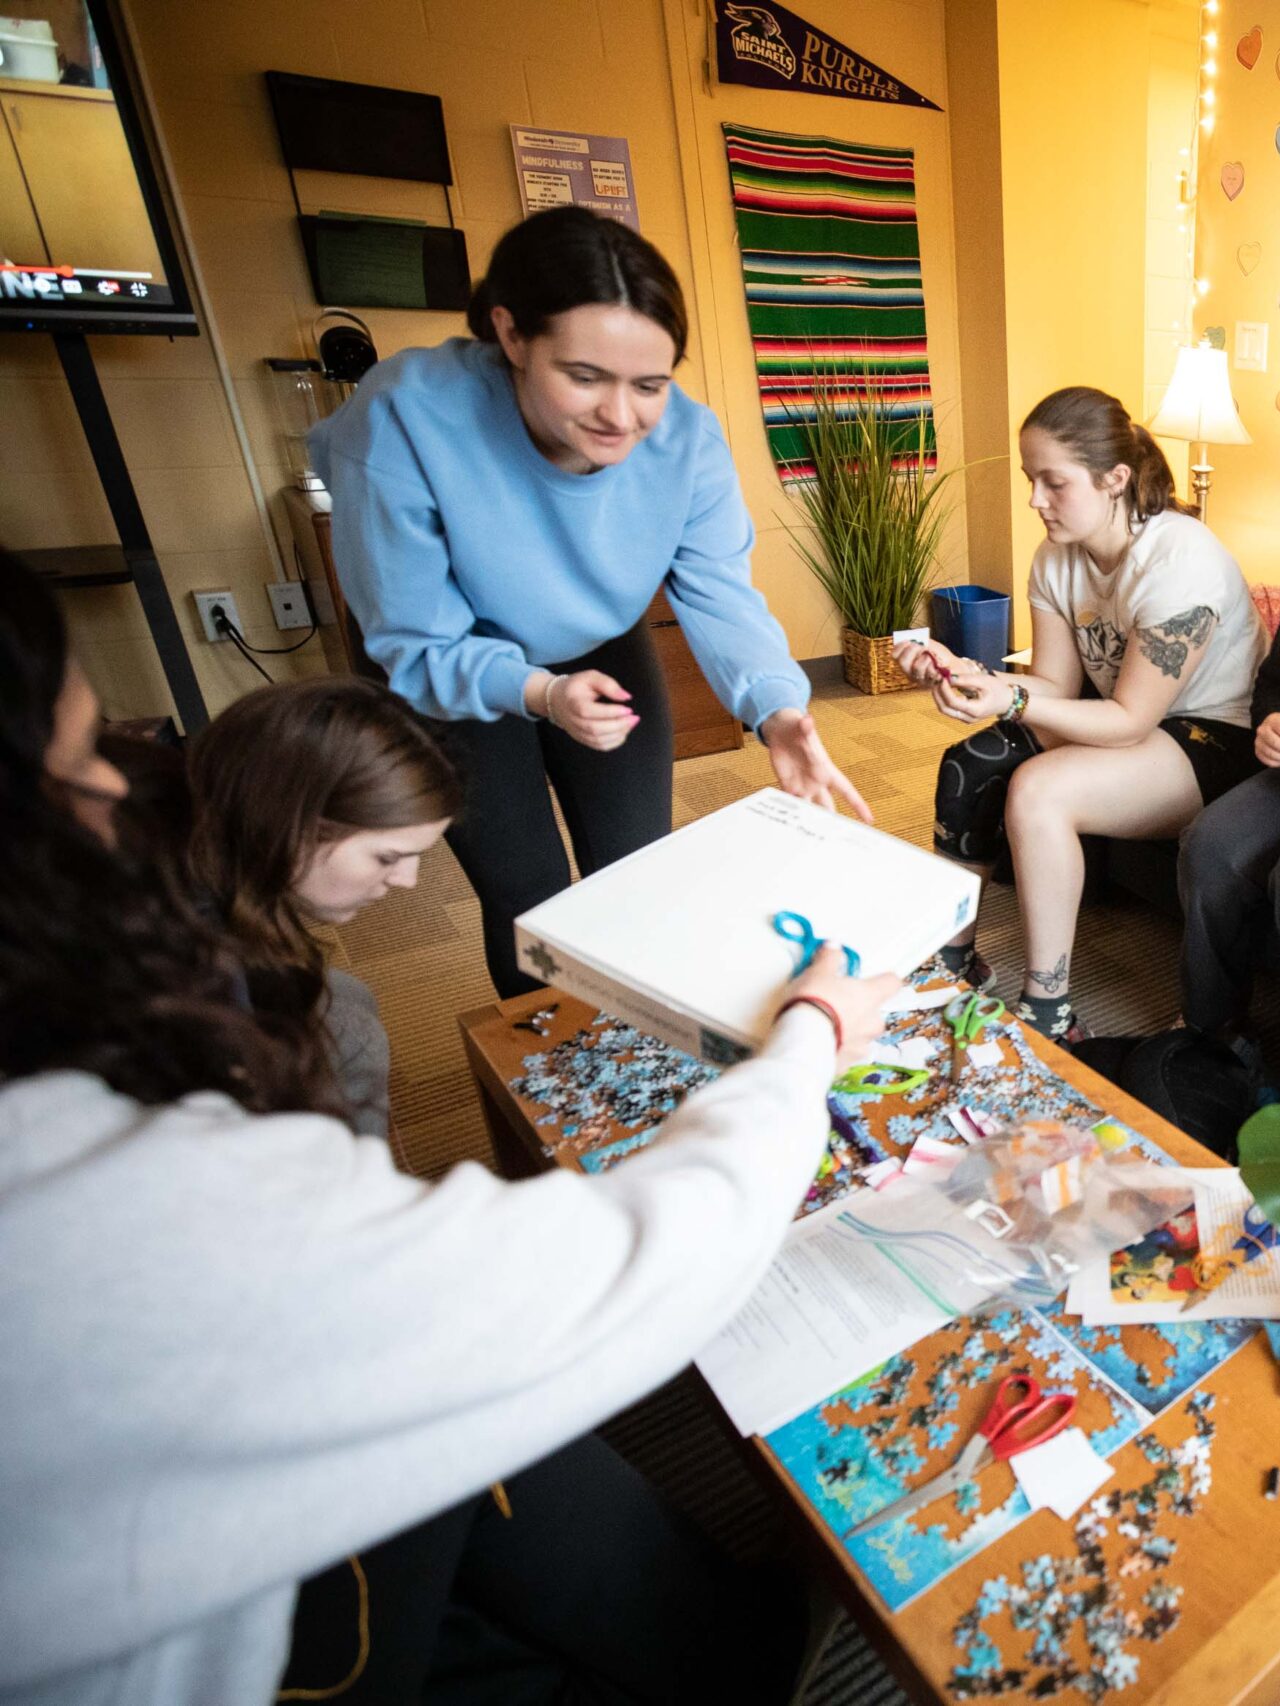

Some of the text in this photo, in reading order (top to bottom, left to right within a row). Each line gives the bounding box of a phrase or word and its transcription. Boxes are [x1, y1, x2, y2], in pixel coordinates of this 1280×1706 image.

[735, 36, 793, 71] MICHAELS
[741, 31, 786, 54] SAINT
[801, 31, 900, 93] PURPLE
[801, 61, 900, 101] KNIGHTS
[522, 155, 584, 171] MINDFULNESS
[0, 271, 64, 300] NE
